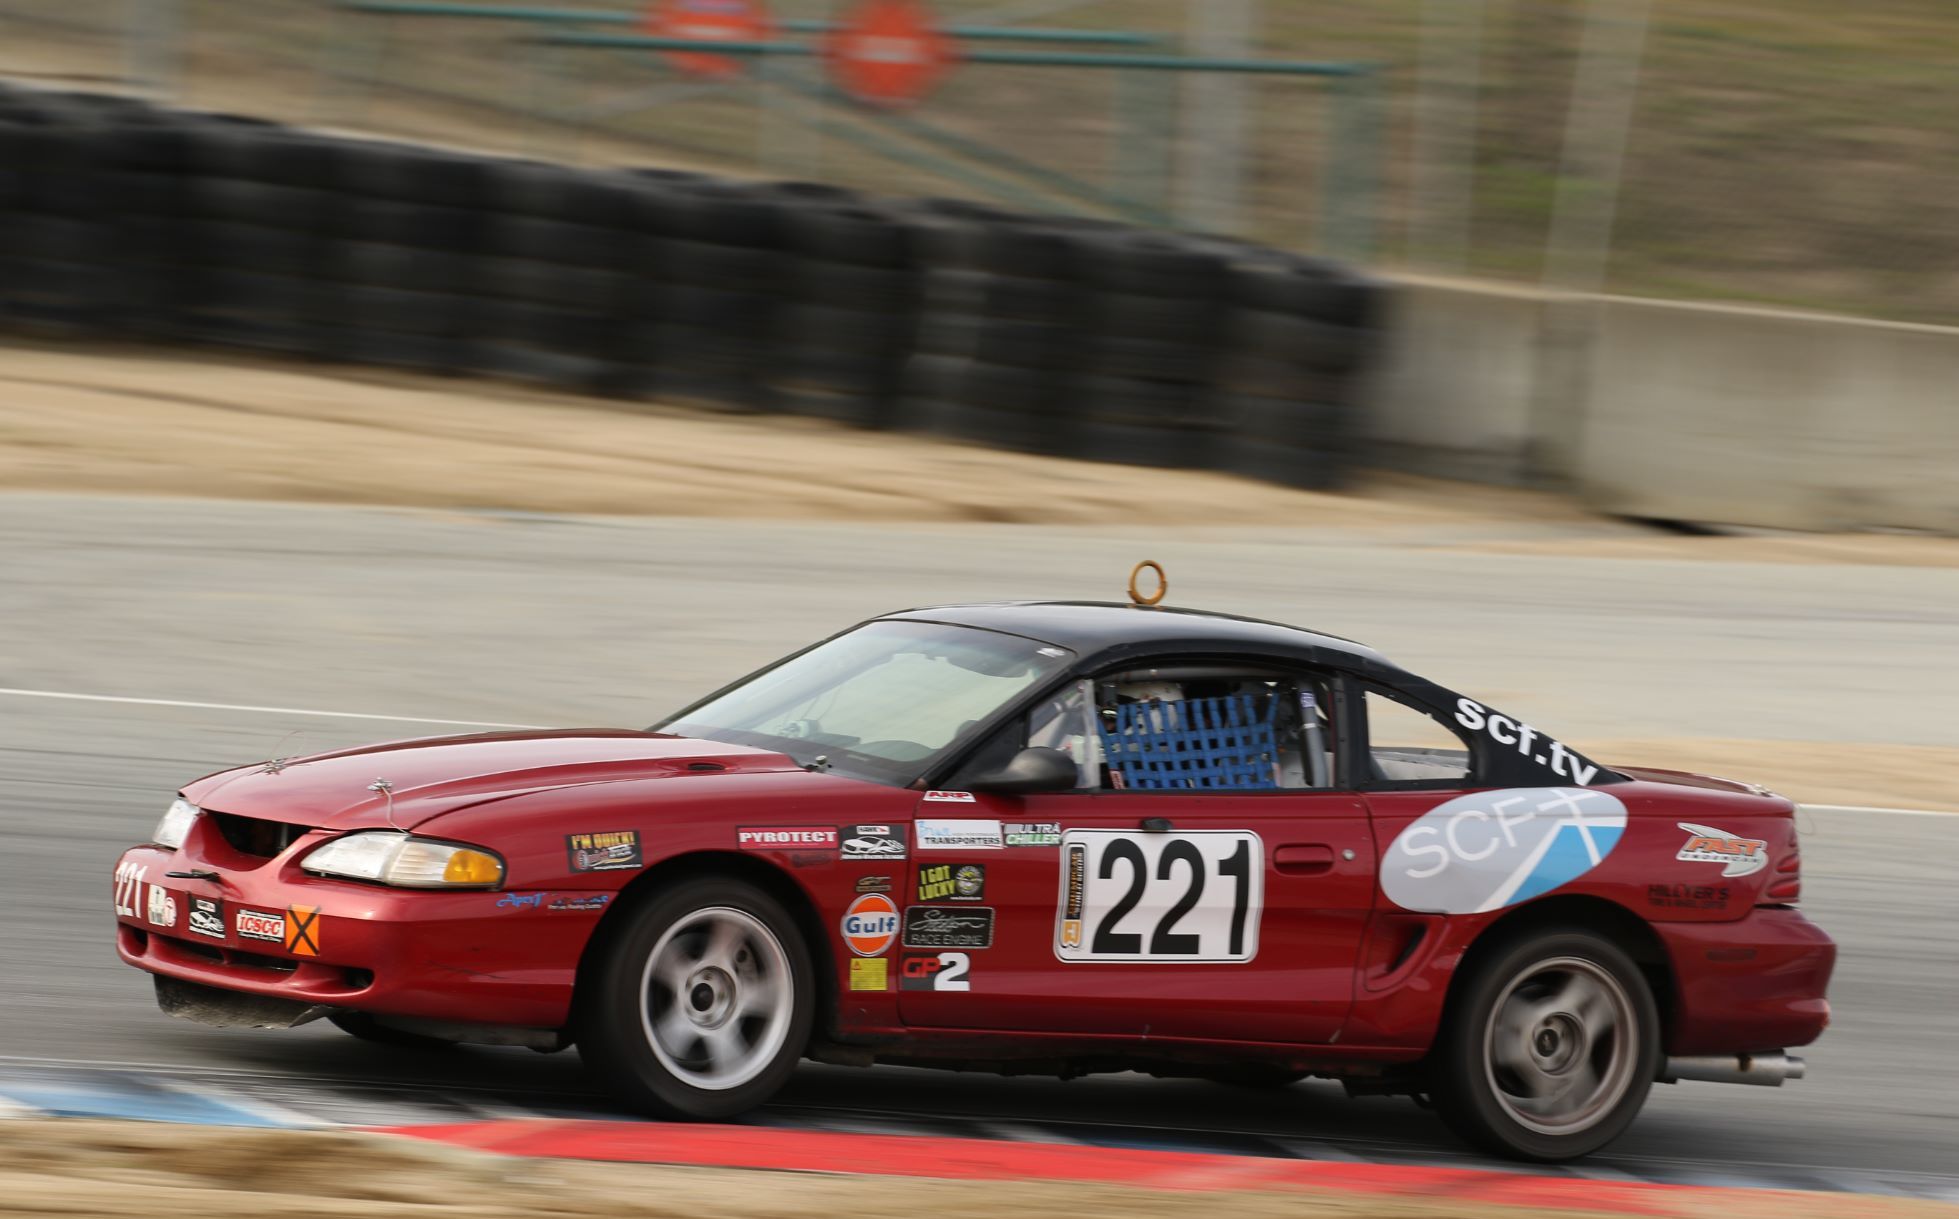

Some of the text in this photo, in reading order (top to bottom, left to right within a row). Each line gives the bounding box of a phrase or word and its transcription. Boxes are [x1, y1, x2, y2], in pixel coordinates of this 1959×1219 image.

[1454, 698, 1598, 787] scf.tv
[739, 831, 837, 843] PYROTECT
[1020, 823, 1060, 834] ULTRA
[924, 837, 1000, 845] TRANSPORTERS
[1006, 834, 1060, 845] CHILLER
[1687, 837, 1762, 856] FAST
[920, 865, 950, 885] I GOT
[115, 861, 148, 918] 221
[918, 879, 956, 900] LUCKY
[1091, 837, 1250, 955] 221
[240, 916, 282, 935] ICSCC
[846, 916, 896, 934] Gulf
[910, 934, 984, 945] RACE ENGINE
[903, 952, 971, 992] GP2
